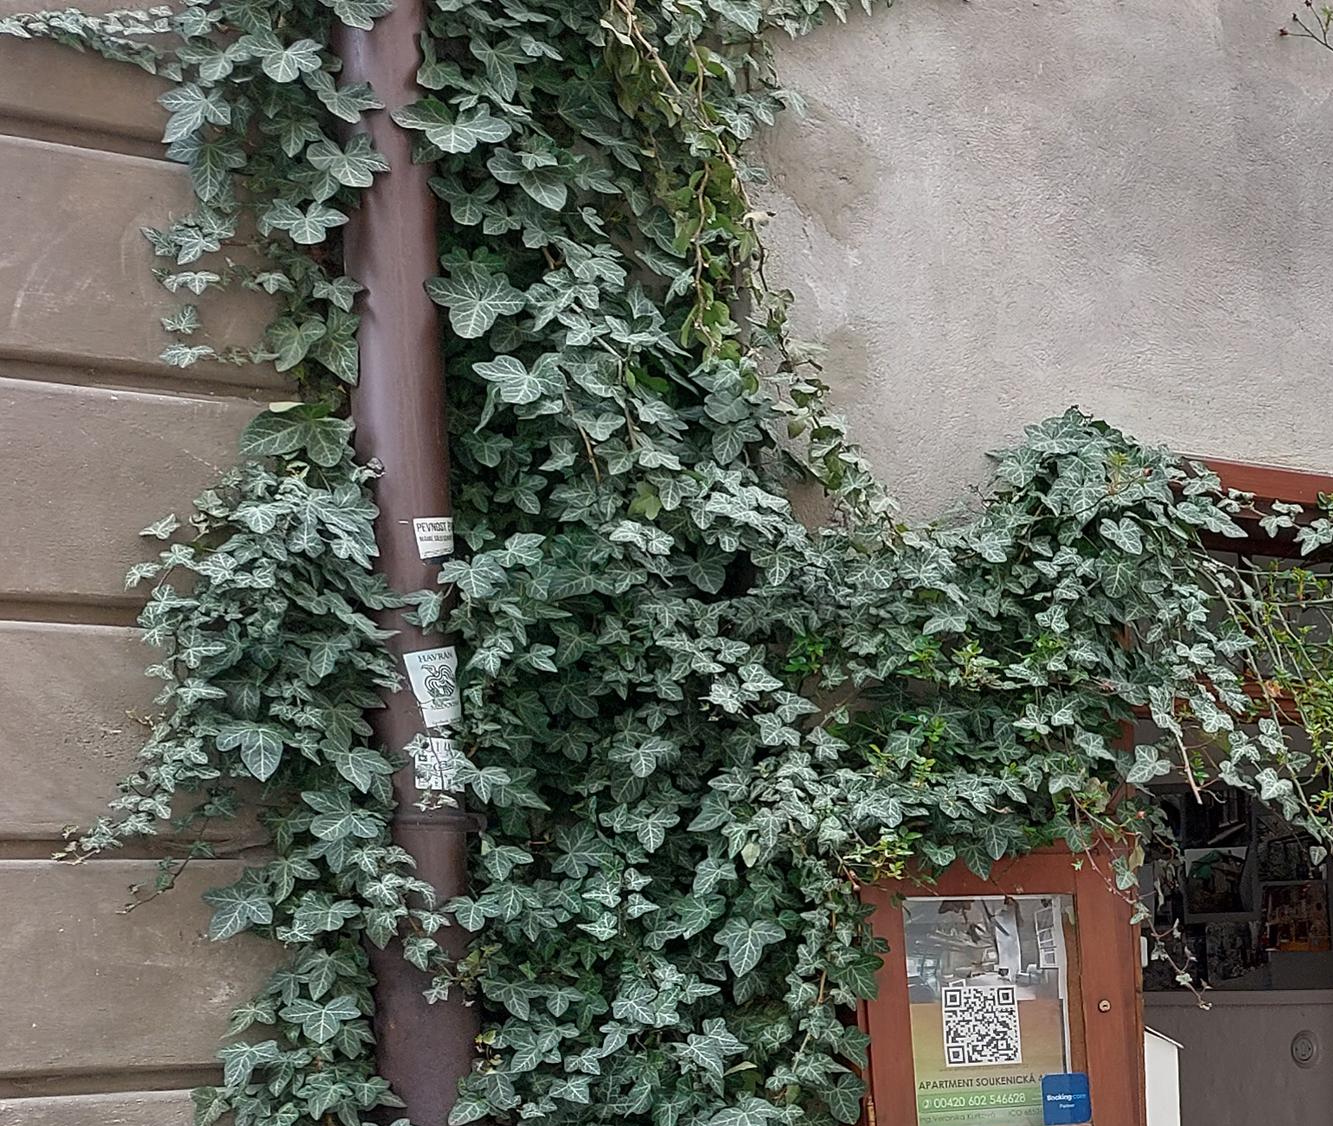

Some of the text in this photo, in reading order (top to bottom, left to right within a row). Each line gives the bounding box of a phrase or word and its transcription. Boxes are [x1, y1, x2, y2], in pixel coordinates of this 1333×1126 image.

[918, 1073, 1036, 1090] APARTMENT SOUKENICKÁ
[933, 1092, 1026, 1109] 00420 602 546628
